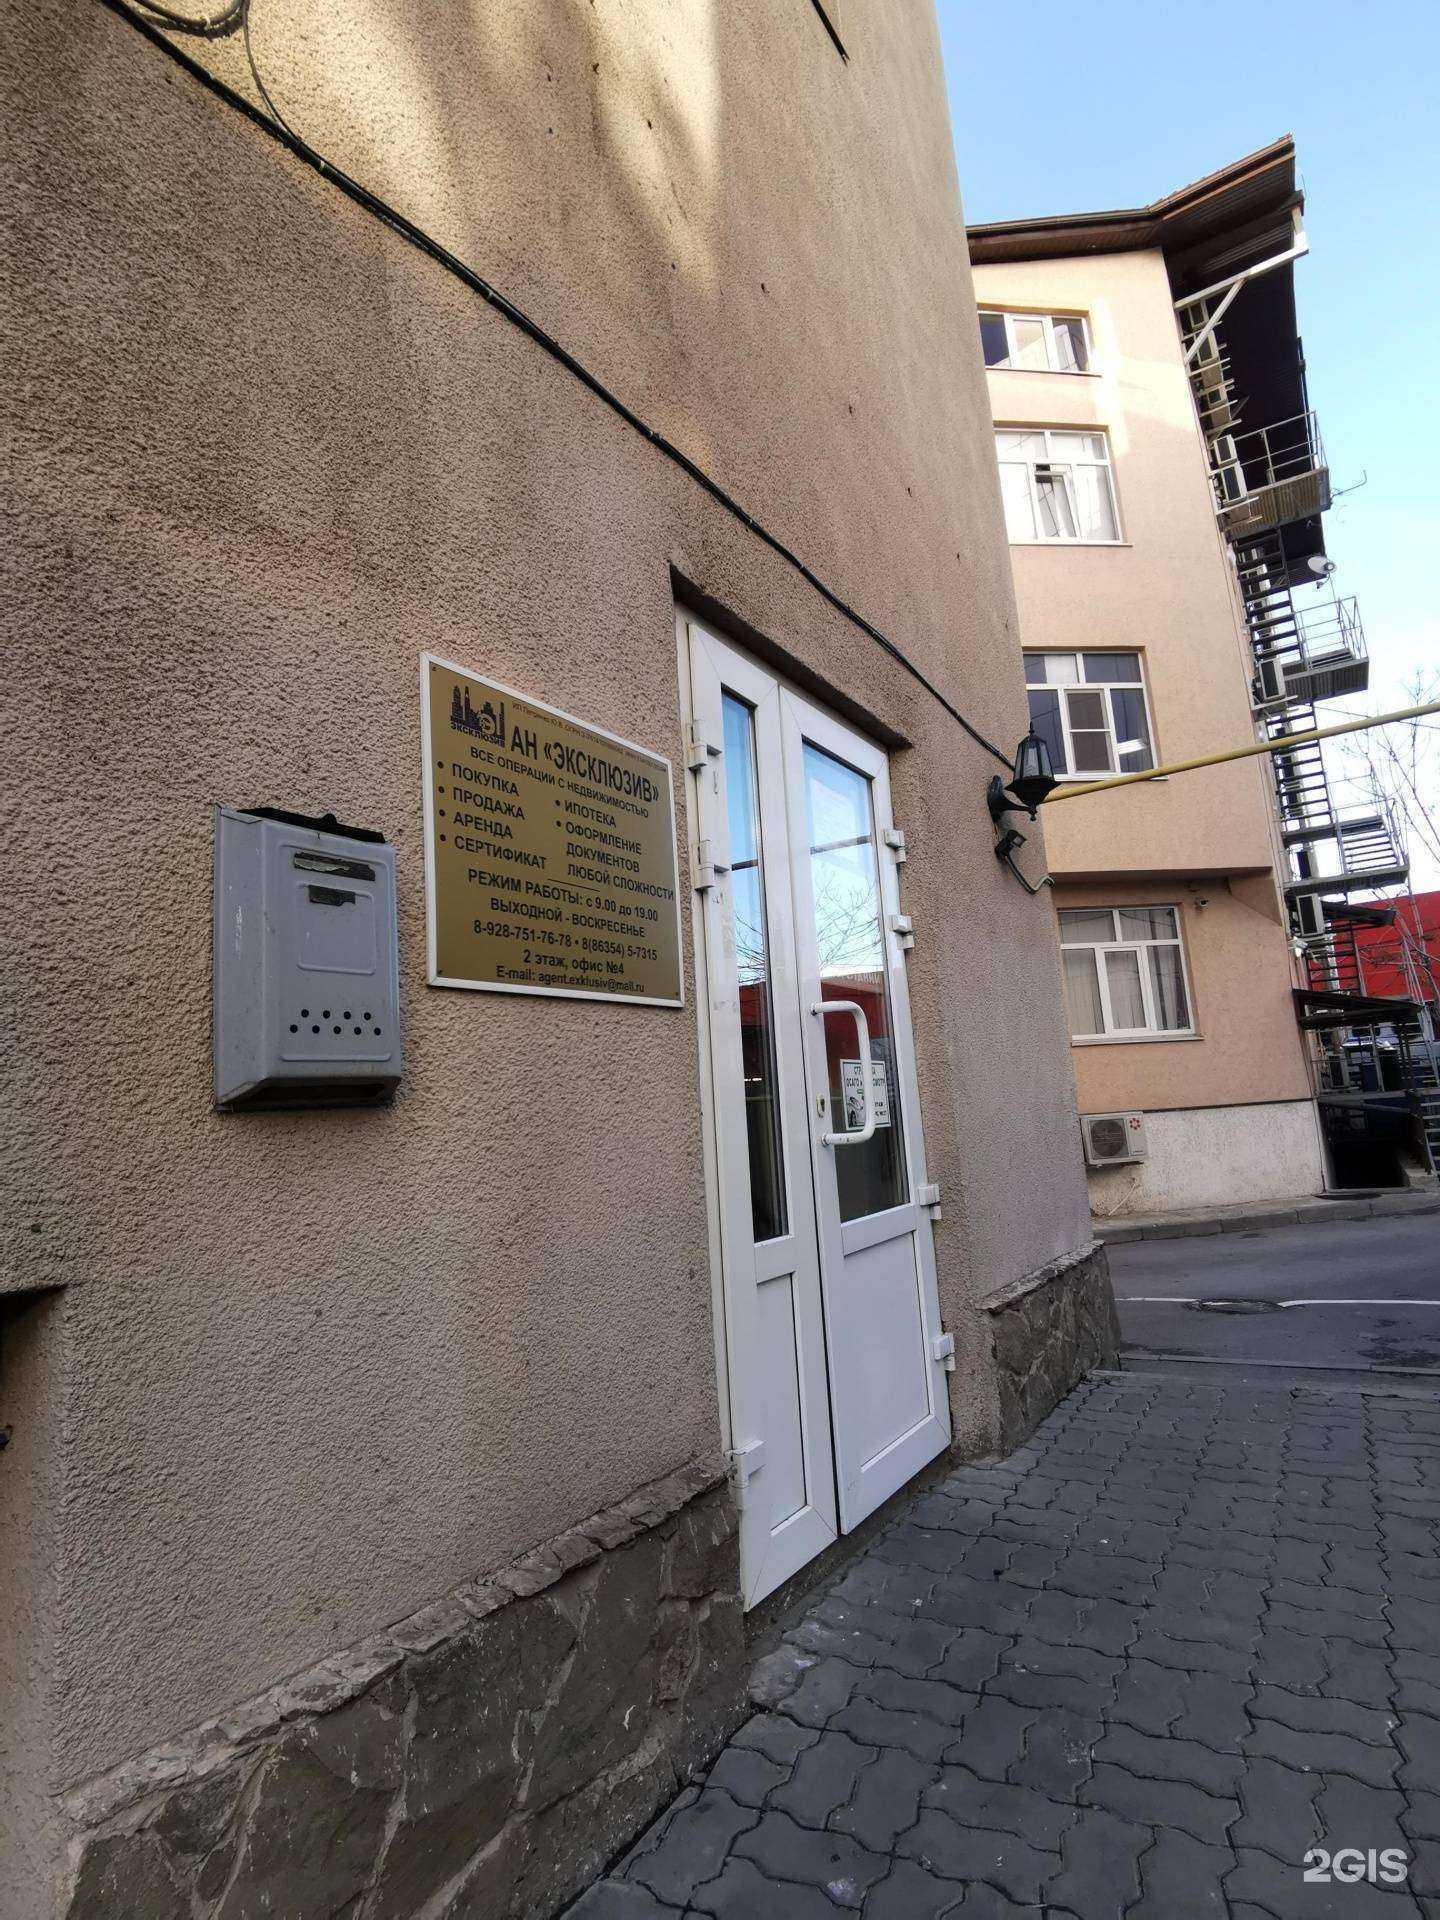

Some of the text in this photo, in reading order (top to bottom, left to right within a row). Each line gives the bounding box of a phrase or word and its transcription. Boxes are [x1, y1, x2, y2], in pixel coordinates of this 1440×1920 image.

[452, 763, 520, 797] ПОКУПКА
[510, 725, 537, 760] АН
[543, 741, 659, 803] «ЭКСКЛЮЗИВ»
[470, 746, 649, 818] ВСЕ ОПЕРАЦИИ С НЕДВИЖИМОСТЬЮ
[453, 787, 525, 820] ПРОДАЖА
[564, 799, 617, 828] ИПОТЕКА
[453, 811, 513, 839] АРЕНДА
[565, 821, 642, 855] ОФОРМЛЕНИЕ
[454, 835, 547, 870] СЕРТИФИКАТ
[566, 842, 640, 873] ДОКУМЕНТОВ
[468, 868, 521, 892] РЕЖИМ
[525, 881, 583, 906] РАБОТЫ:
[595, 896, 617, 913] 9.00
[619, 905, 632, 917] до
[634, 906, 658, 922] 19.00
[567, 863, 674, 901] ЛЮБОЙ СЛОЖНОСТИ
[490, 897, 562, 922] ВЫХОДНОЙ
[572, 913, 646, 938] ВОСКРЕСЕНЬЕ
[473, 919, 658, 961] 8-928-751-76-78 8(86354) 5-7315
[496, 965, 536, 981] E-mail:
[523, 949, 625, 975] 2 этаж, офис №4
